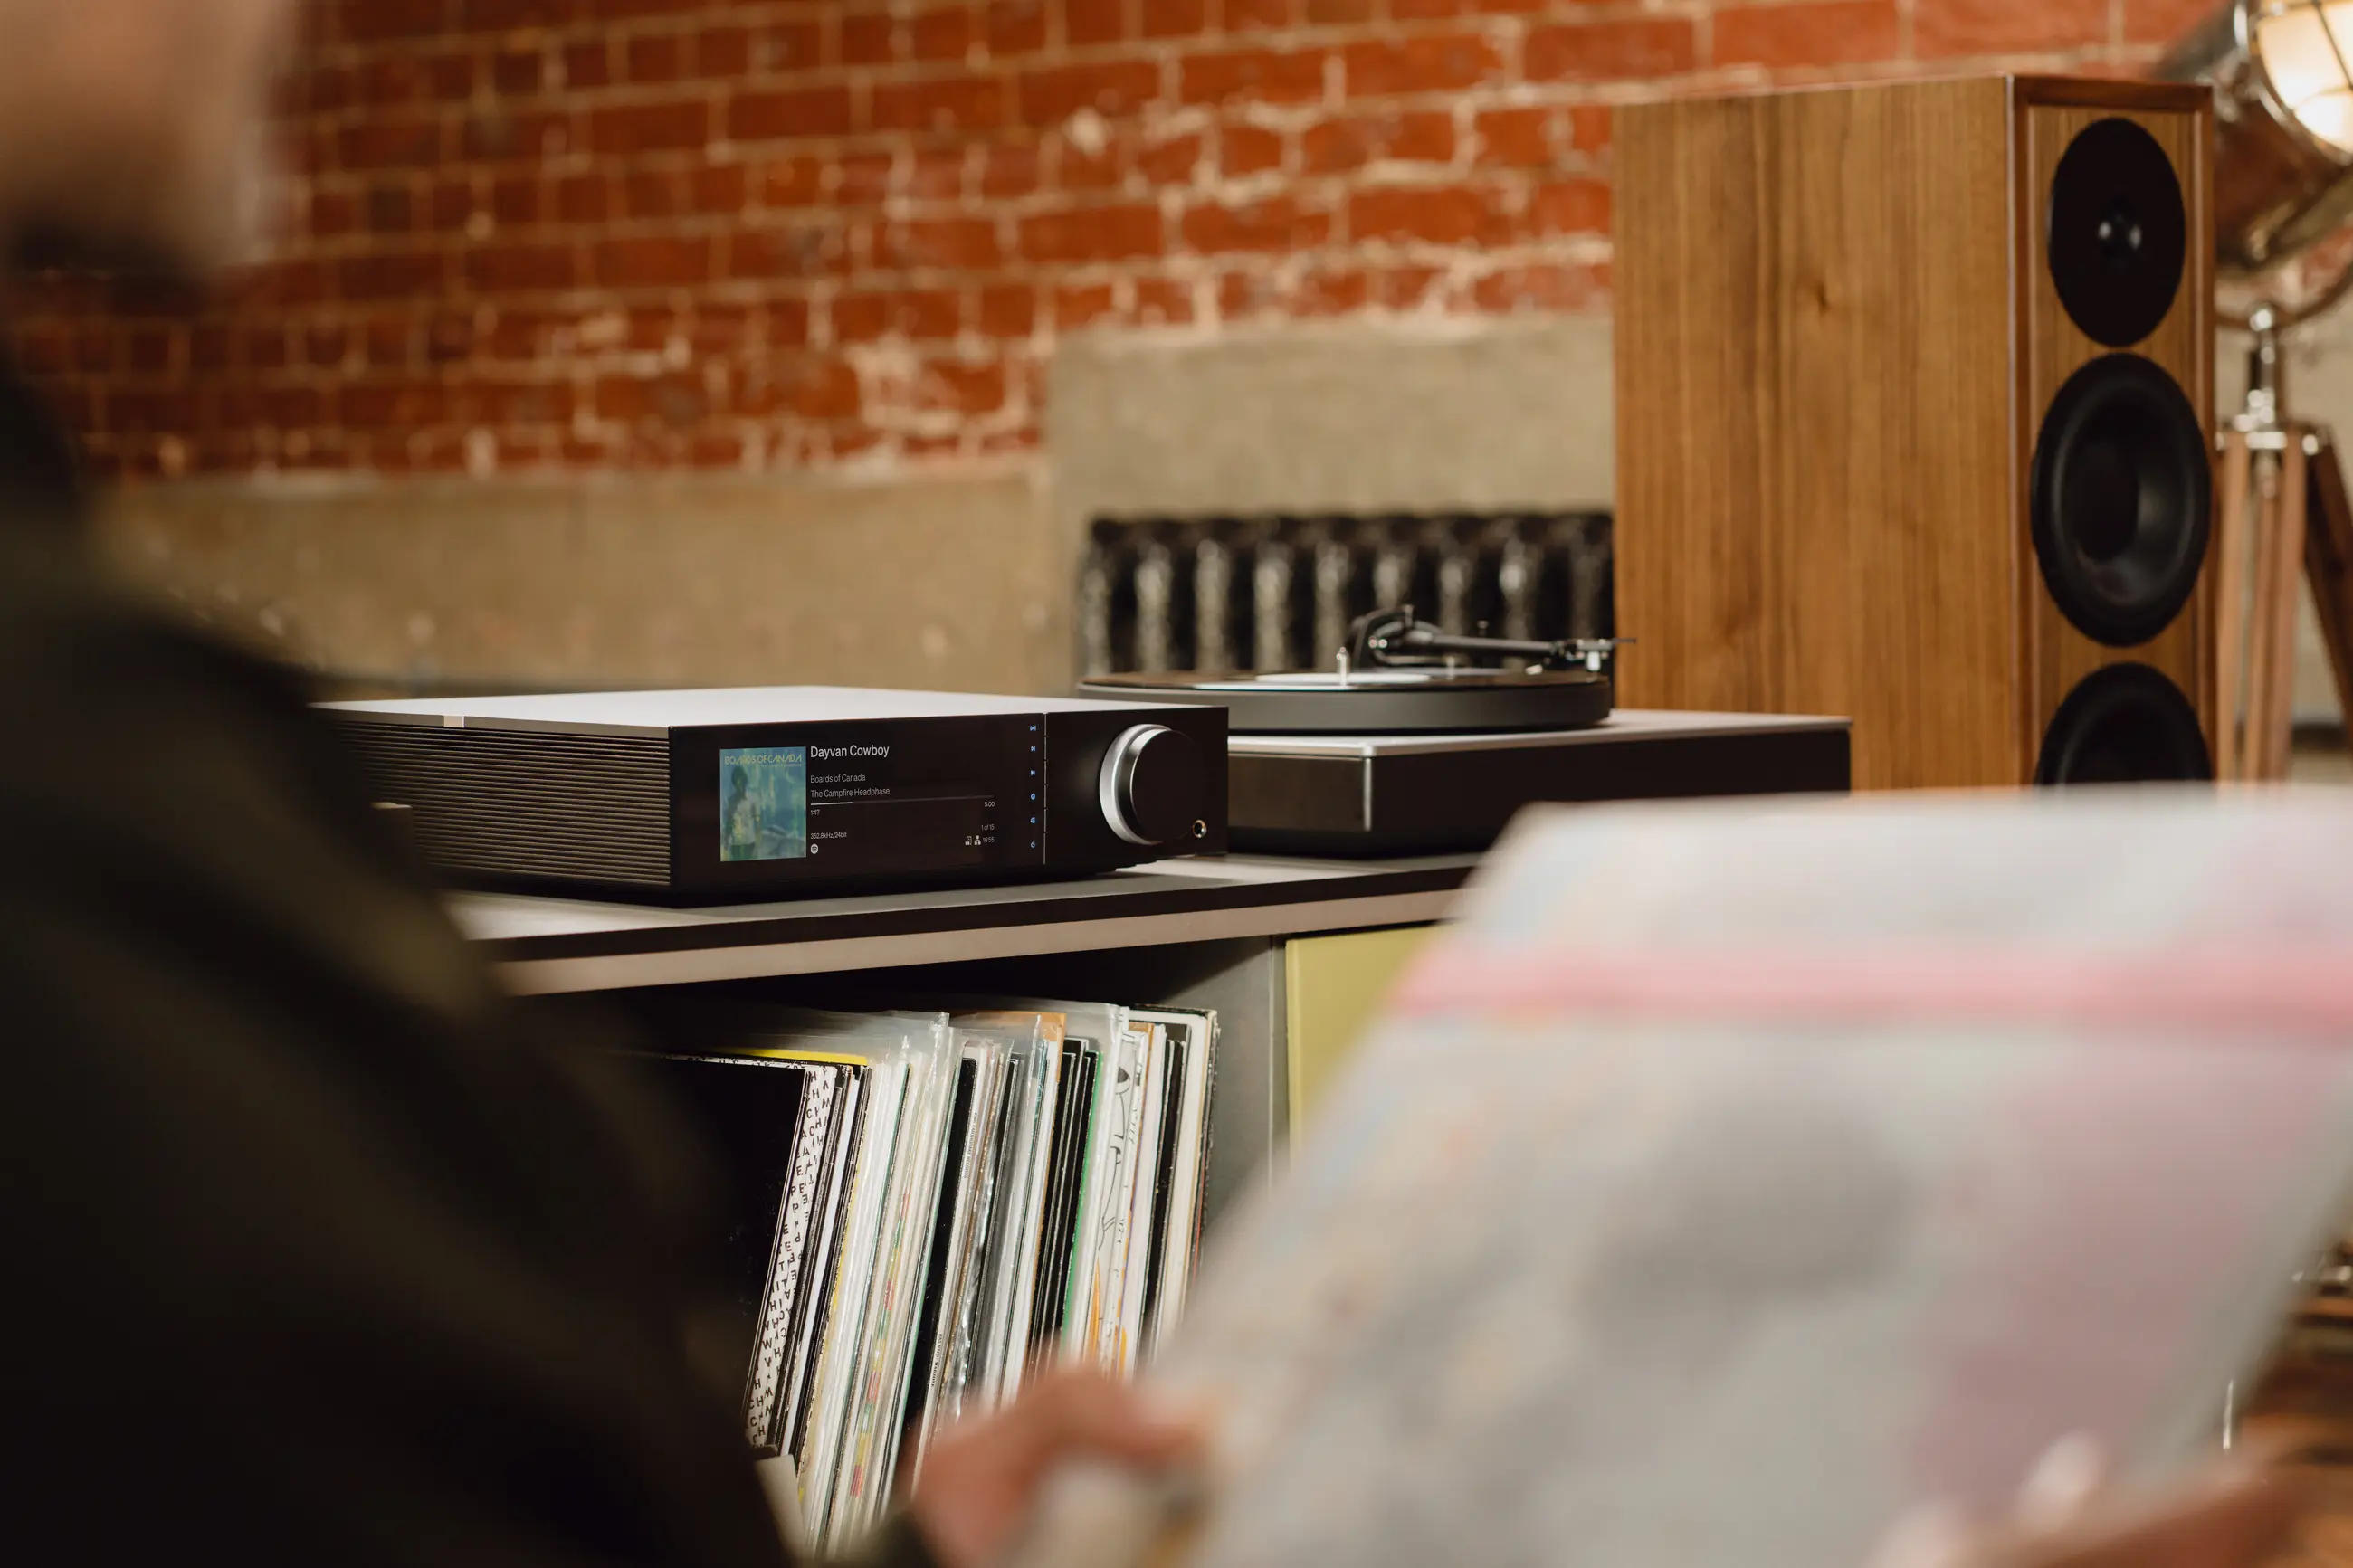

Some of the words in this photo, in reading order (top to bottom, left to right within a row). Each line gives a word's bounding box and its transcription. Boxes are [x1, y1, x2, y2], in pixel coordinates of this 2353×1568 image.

[810, 746, 847, 760] Dayvan
[849, 744, 890, 758] Cowboy
[724, 755, 757, 765] BOARDS
[757, 755, 767, 764] OF
[767, 753, 802, 763] CANADA
[810, 774, 834, 784] Boards
[834, 774, 841, 783] of
[841, 774, 866, 783] Canada
[810, 789, 823, 798] The
[824, 788, 853, 799] Campfire
[853, 787, 891, 797] Headphase
[810, 808, 821, 816] 1:47
